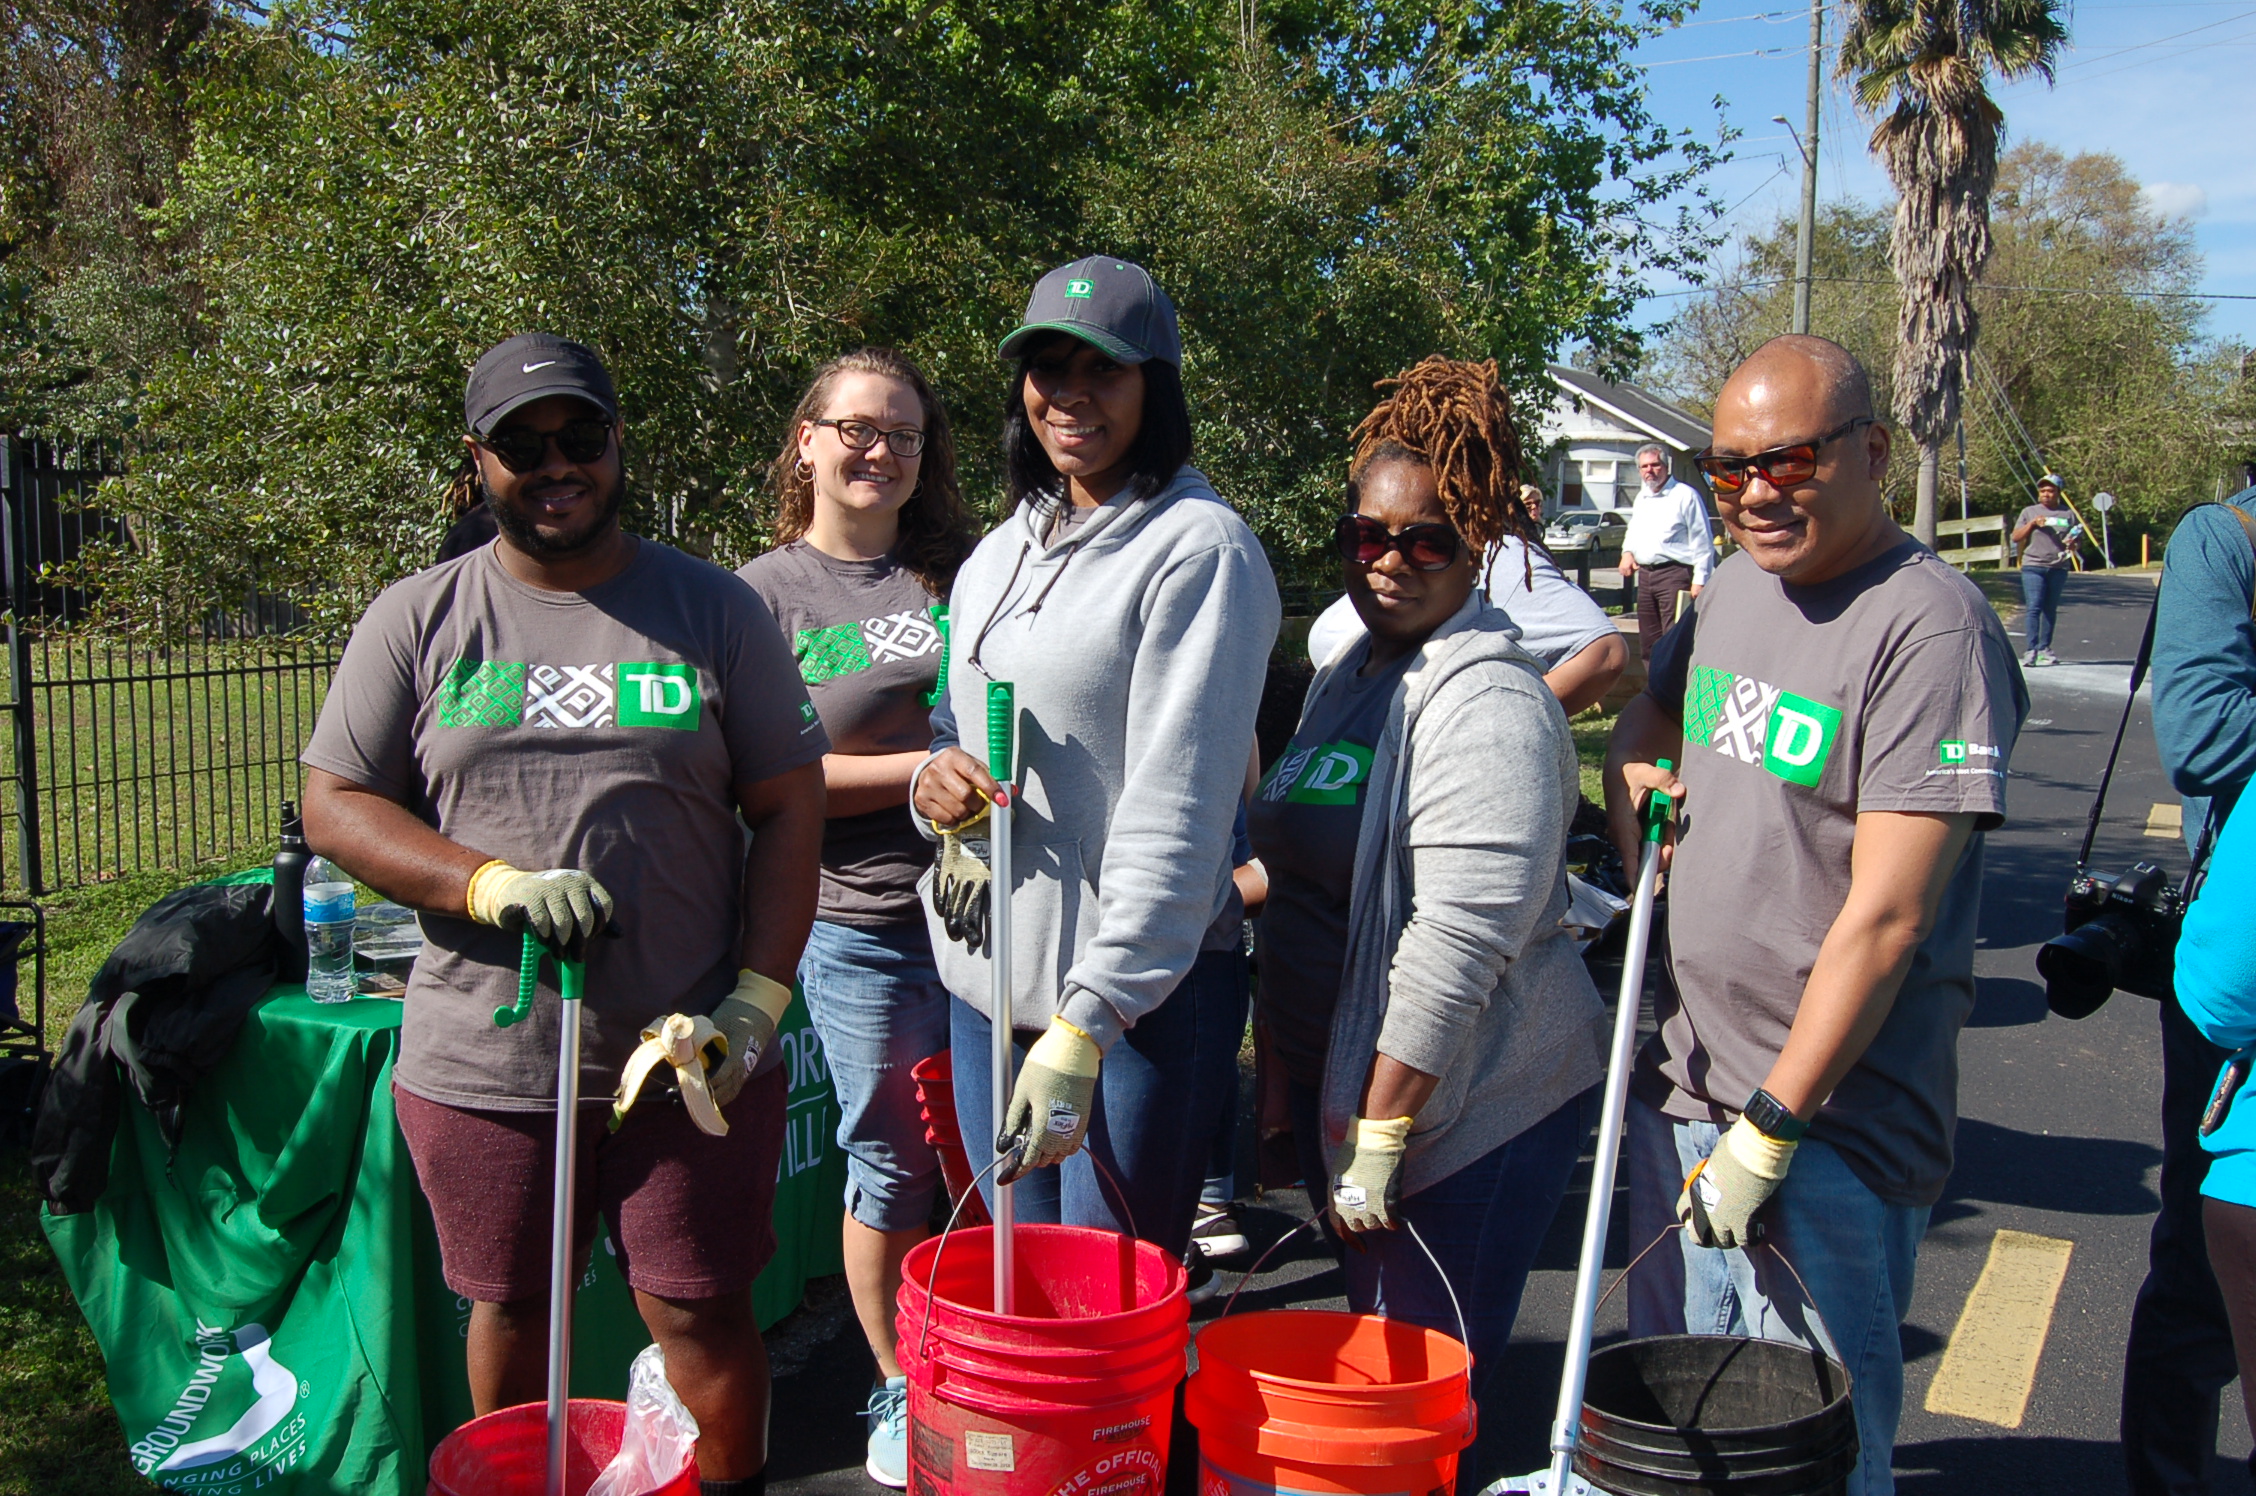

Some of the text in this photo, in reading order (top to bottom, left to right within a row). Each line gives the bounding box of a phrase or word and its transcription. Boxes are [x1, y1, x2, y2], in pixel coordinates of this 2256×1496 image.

[1070, 281, 1091, 294] TD
[626, 673, 692, 715] TD
[801, 703, 813, 718] TD
[1771, 706, 1823, 766] TD
[1942, 743, 1964, 759] TD
[1304, 751, 1359, 790] TD
[2111, 892, 2134, 904] Nikon
[130, 1317, 230, 1476] GROUNDWORK
[1092, 1414, 1152, 1441] FIREHOUSE
[164, 1411, 306, 1488] NGING PLACES
[255, 1440, 306, 1489] LIVES
[1054, 1449, 1162, 1496] HE OFFICIAL
